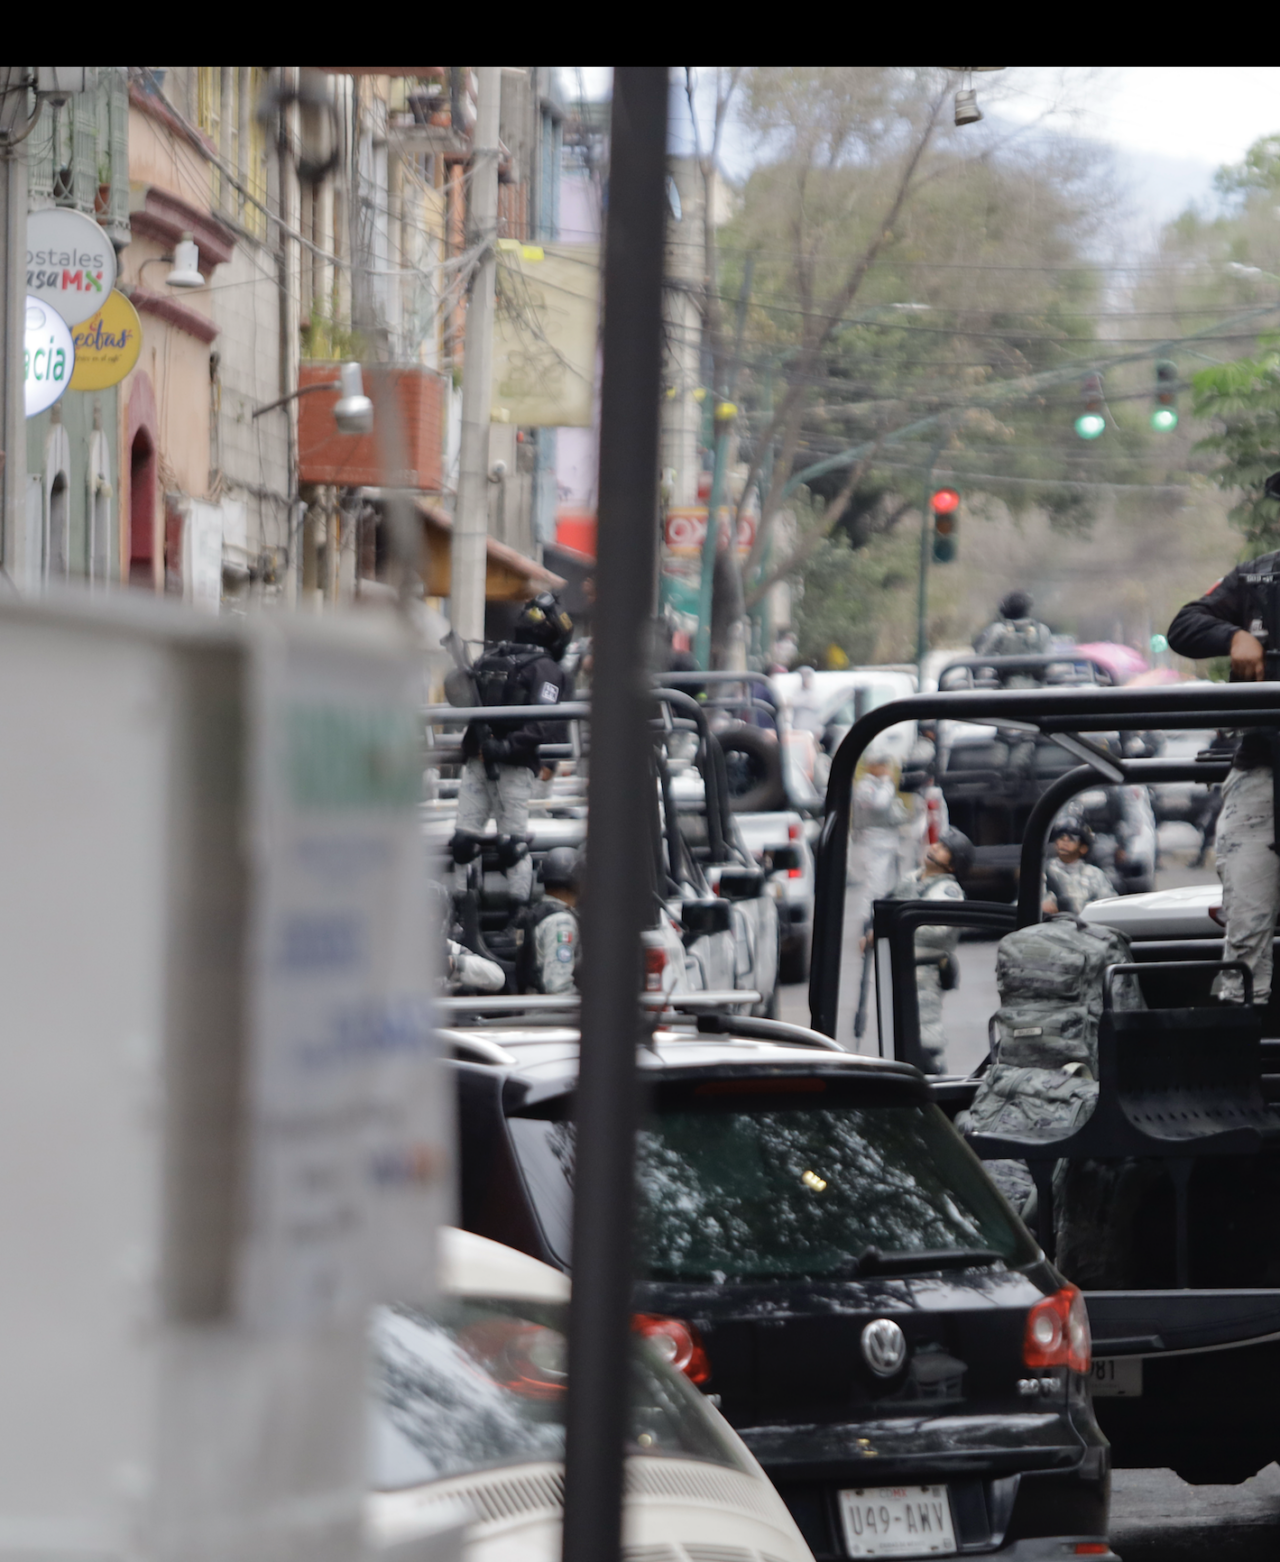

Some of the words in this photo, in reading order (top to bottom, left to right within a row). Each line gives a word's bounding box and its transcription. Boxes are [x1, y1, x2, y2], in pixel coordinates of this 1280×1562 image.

[668, 517, 753, 545] OXO
[1090, 1360, 1115, 1380] 81
[849, 1502, 944, 1536] U49-AWV
